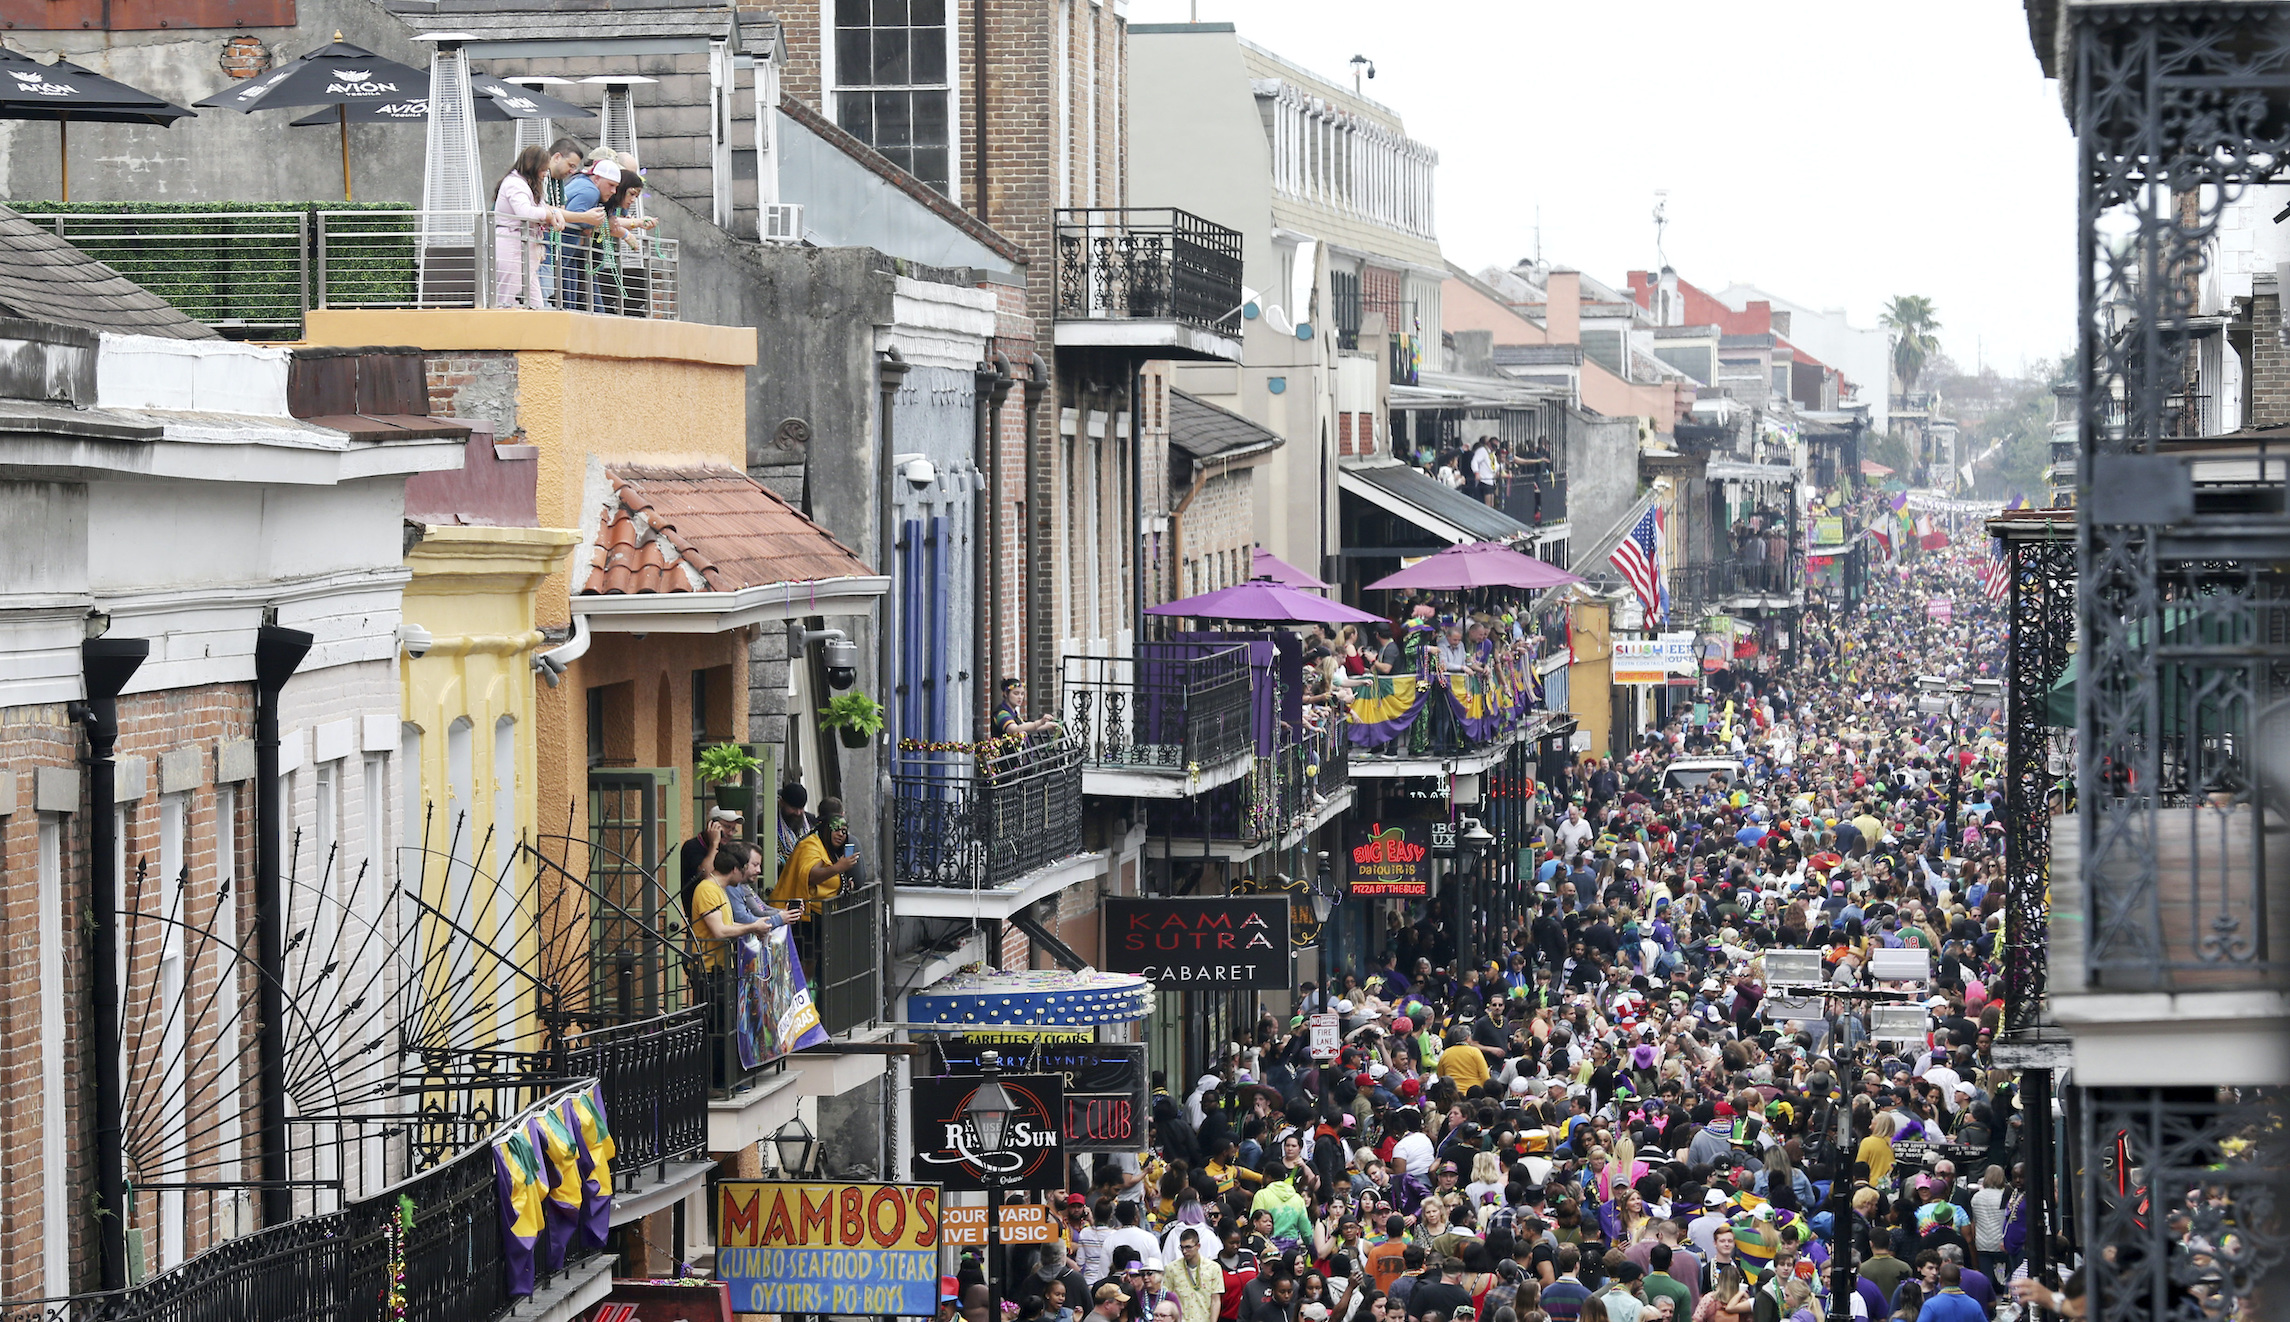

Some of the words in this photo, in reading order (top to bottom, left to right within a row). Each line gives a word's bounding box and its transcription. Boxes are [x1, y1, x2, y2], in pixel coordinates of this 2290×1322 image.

[325, 82, 399, 93] AVIÓN
[1616, 645, 1663, 657] SLUSH
[1353, 841, 1382, 863] BIG
[1386, 840, 1426, 863] EASY
[1352, 884, 1376, 894] PIZZA
[1129, 911, 1269, 930] KAMA
[1125, 931, 1273, 950] SUTRA
[1142, 965, 1257, 981] CABARET
[1312, 1016, 1321, 1025] NO
[1045, 1034, 1088, 1044] CIGARS
[975, 1056, 1026, 1066] LRRY
[1086, 1099, 1132, 1140] CLUB
[722, 1185, 938, 1248] MAMBO'S
[942, 1208, 1041, 1224] COURYARD
[942, 1228, 976, 1243] IVE
